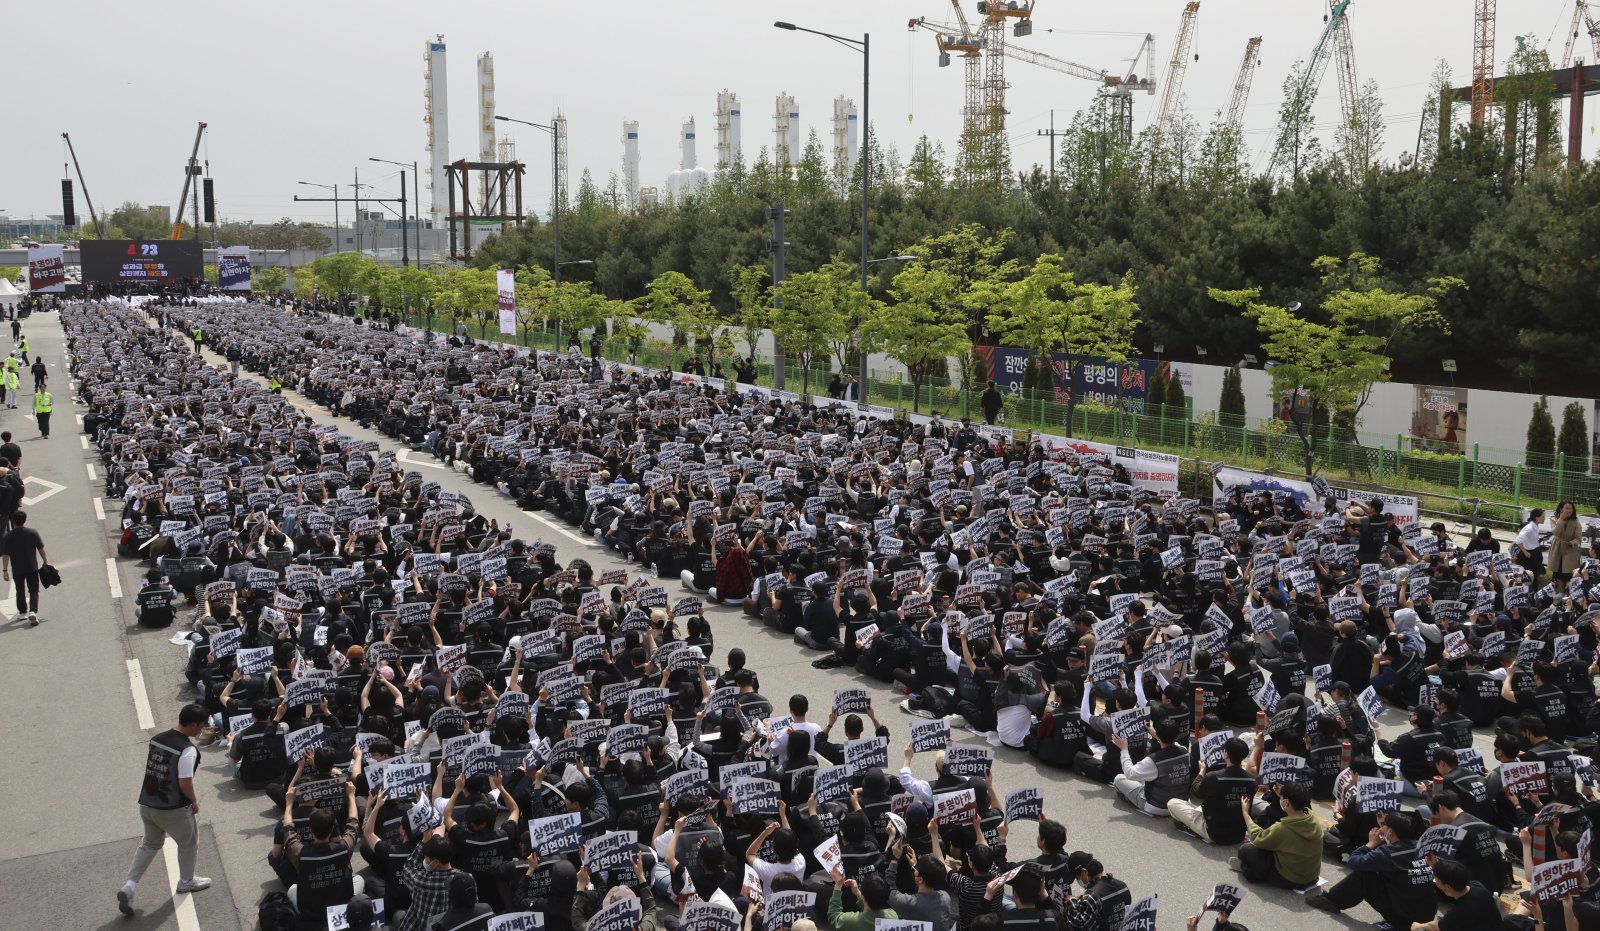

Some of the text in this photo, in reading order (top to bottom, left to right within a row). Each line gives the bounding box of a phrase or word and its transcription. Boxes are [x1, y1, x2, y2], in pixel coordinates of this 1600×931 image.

[142, 244, 158, 255] 23
[1084, 364, 1117, 386] 평생의
[1122, 367, 1145, 392] 상처
[1117, 448, 1134, 457] NSEU
[415, 554, 440, 564] 상한폐지
[416, 563, 440, 574] 실현하자
[483, 569, 507, 580] 실현하자
[250, 581, 276, 589] 실현하자
[291, 581, 317, 590] 실현하자
[896, 580, 920, 591] 바꾸고!!!
[399, 603, 427, 614] 상한폐지
[464, 600, 490, 615] 상한폐지
[533, 601, 559, 610] 상한폐지
[641, 596, 666, 607] 실현하자
[1330, 597, 1358, 610] 상한폐지
[467, 609, 494, 624] 실현하자
[675, 605, 699, 616] 실현하자
[904, 606, 928, 615] 바꾸고!!!
[1334, 610, 1361, 620] 실현하자
[401, 613, 429, 624] 실현하자
[212, 630, 238, 645] 상한폐지
[523, 632, 551, 648] 상한폐지
[574, 636, 601, 650] 상한폐지
[216, 642, 241, 659] 실현하자
[239, 648, 270, 661] 상한폐지
[439, 646, 465, 660] 투명하게
[524, 643, 554, 659] 실현하자
[575, 648, 604, 661] 실현하자
[242, 660, 273, 674] 실현하자
[670, 660, 700, 670] 실현하자
[1092, 655, 1120, 670] 상한폐지
[1093, 667, 1120, 681] 실현하자
[287, 681, 320, 696] 상한폐지
[549, 681, 578, 694] 상한폐지
[288, 693, 323, 707] 실현하자
[550, 689, 582, 704] 실현하자
[630, 690, 664, 704] 상한폐지
[835, 690, 866, 702] 상한폐지
[632, 703, 668, 717] 실현하자
[836, 701, 870, 715] 실현하자
[1114, 708, 1145, 727] 상한폐지
[288, 725, 319, 749] 상한폐지
[609, 726, 643, 740] 상한폐지
[910, 722, 944, 739] 상한폐지
[1120, 720, 1150, 739] 실현하자
[610, 740, 646, 756] 실현하자
[846, 738, 881, 758] 상한폐지
[913, 736, 948, 752] 실현하자
[1202, 734, 1227, 754] 상한폐지
[465, 746, 496, 766] 상한폐지
[949, 748, 988, 760] 상한폐지
[464, 762, 499, 778] 실현하자
[949, 762, 989, 773] 실현하자
[1263, 756, 1298, 770] 상한폐지
[386, 766, 425, 783] 상한폐지
[723, 763, 761, 783] 상한폐지
[816, 767, 847, 789] 상한폐지
[1263, 773, 1301, 784] 실현하자
[1503, 763, 1540, 780] 투명하게
[389, 780, 432, 799] 실현하자
[668, 771, 702, 793] 상한폐지
[734, 779, 775, 796] 상한폐지
[1359, 783, 1396, 794] 상한폐지
[1509, 780, 1546, 794] 바꾸고!!!
[302, 786, 344, 800] 실현하자
[817, 782, 853, 803] 실현하자
[739, 794, 780, 810] 실현하자
[937, 792, 972, 810] 투명하게
[1361, 799, 1400, 812] 실현하자
[940, 808, 976, 826] 바꾸고!!!
[1006, 803, 1041, 820] 실현하자
[534, 816, 574, 840] 상한폐지
[1421, 828, 1458, 843] 상한폐지
[539, 833, 582, 856] 실현하자
[588, 833, 631, 858] 상한폐지
[589, 852, 636, 873] 실현하자
[1533, 861, 1574, 884] 투명하게
[1539, 878, 1577, 900] 바꾸고!!!
[767, 892, 809, 915] 상한폐지
[686, 903, 735, 920] 상한폐지
